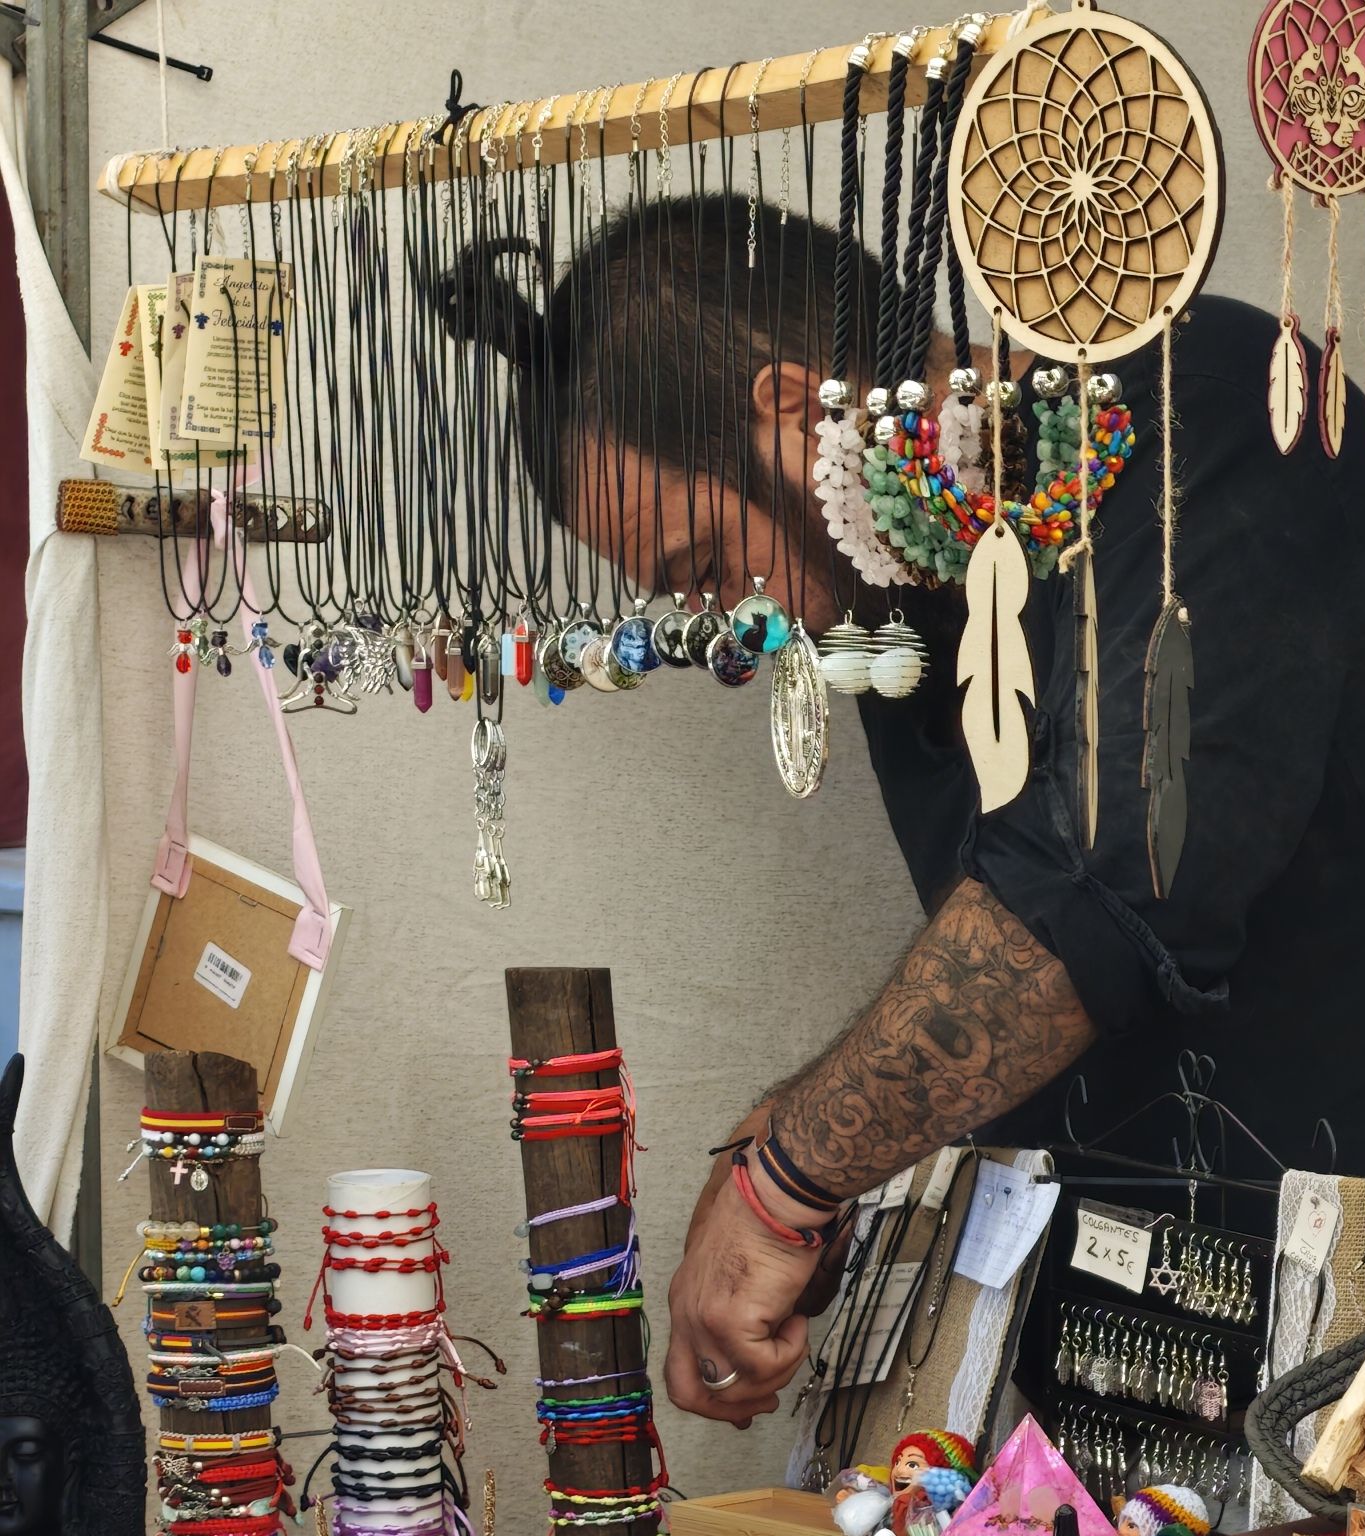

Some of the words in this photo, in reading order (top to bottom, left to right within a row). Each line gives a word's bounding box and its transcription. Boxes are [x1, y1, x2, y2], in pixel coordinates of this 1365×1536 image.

[213, 275, 269, 293] Angelto
[212, 309, 268, 330] Felcidd
[1082, 1214, 1140, 1244] COLGANTES
[1086, 1236, 1099, 1259] 2
